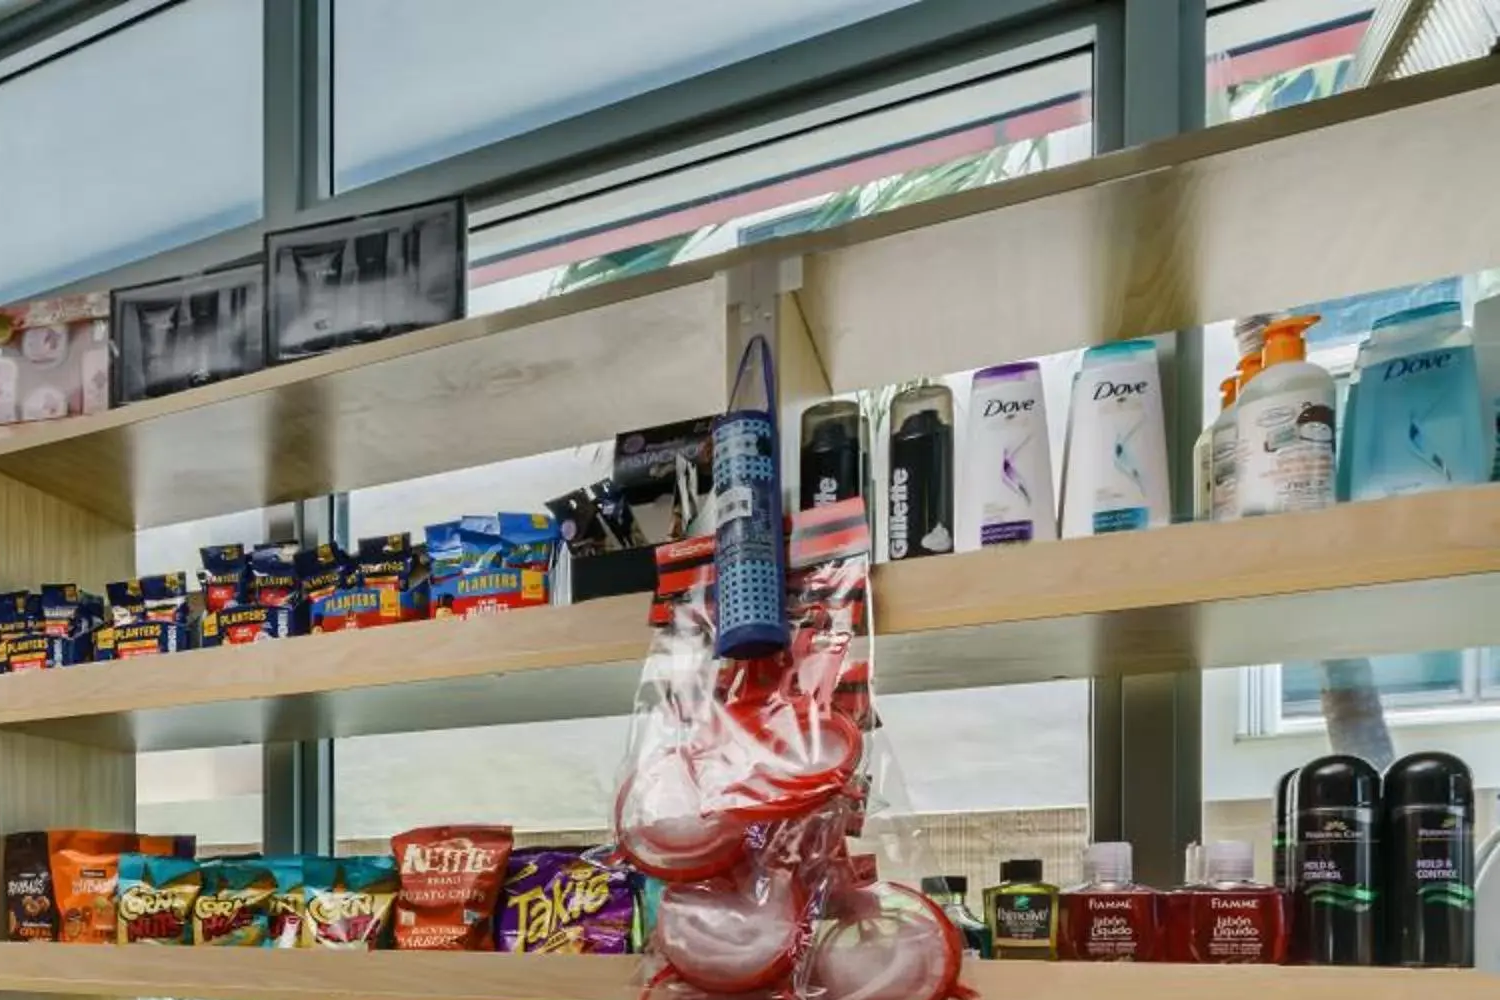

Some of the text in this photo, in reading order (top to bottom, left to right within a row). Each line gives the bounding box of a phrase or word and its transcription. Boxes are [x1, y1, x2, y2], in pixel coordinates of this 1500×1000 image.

[1384, 351, 1452, 381] Dove
[1093, 379, 1148, 400] Dove
[983, 399, 1035, 418] Dove
[889, 467, 909, 558] Gillette
[457, 573, 518, 595] PLANTERS
[324, 593, 378, 612] PLANTERS
[220, 608, 268, 626] PLANTERS
[114, 624, 163, 641] PLANTERS
[7, 637, 49, 654] PLANTERS
[508, 871, 611, 954] Takis
